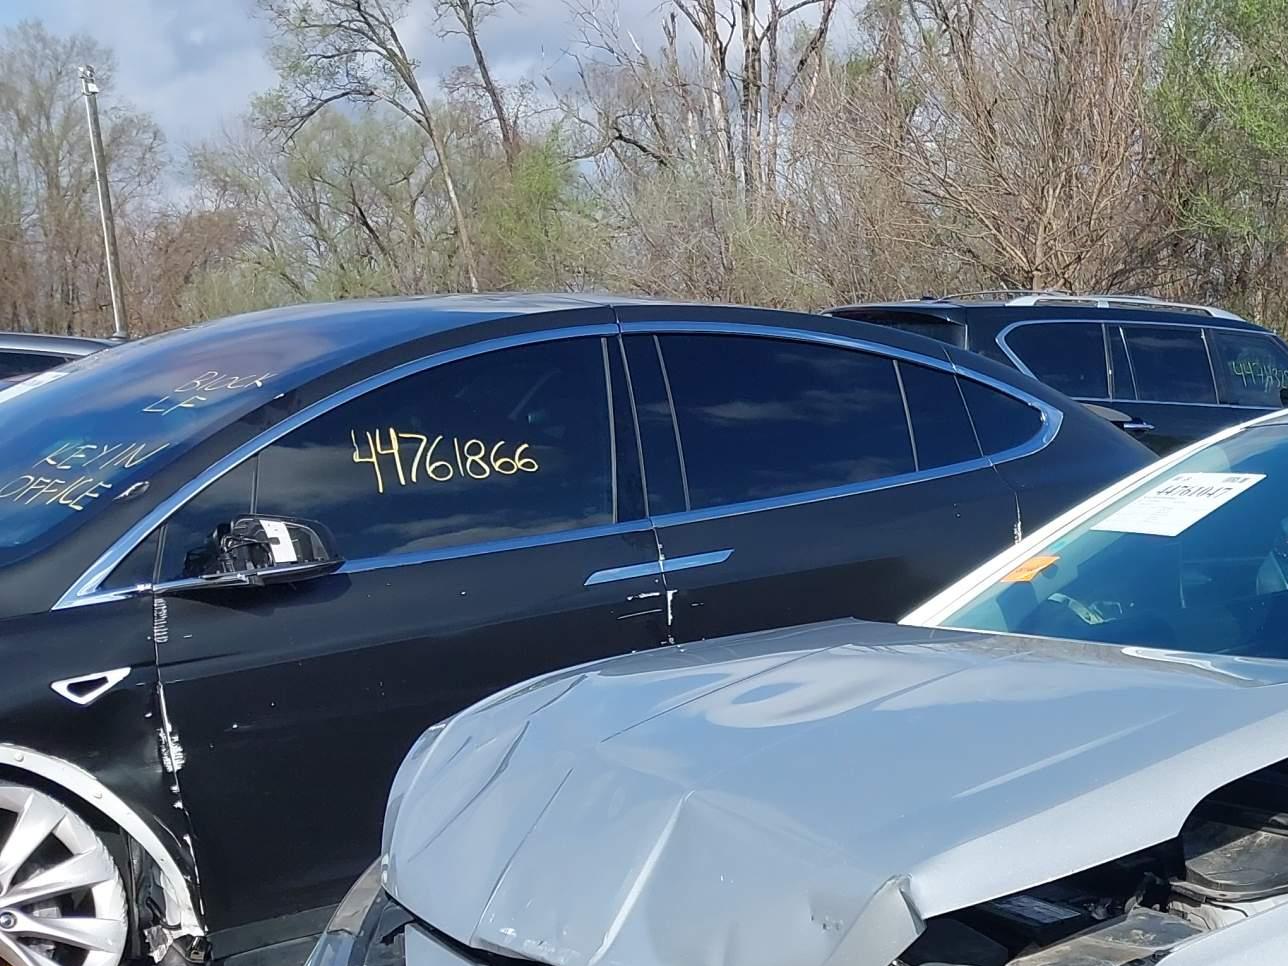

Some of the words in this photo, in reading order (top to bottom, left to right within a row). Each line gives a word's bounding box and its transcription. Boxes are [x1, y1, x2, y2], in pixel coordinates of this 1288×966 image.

[141, 394, 208, 416] LF
[350, 427, 539, 494] 44761866
[0, 474, 112, 512] OFFICE
[1156, 484, 1234, 499] 44761047
